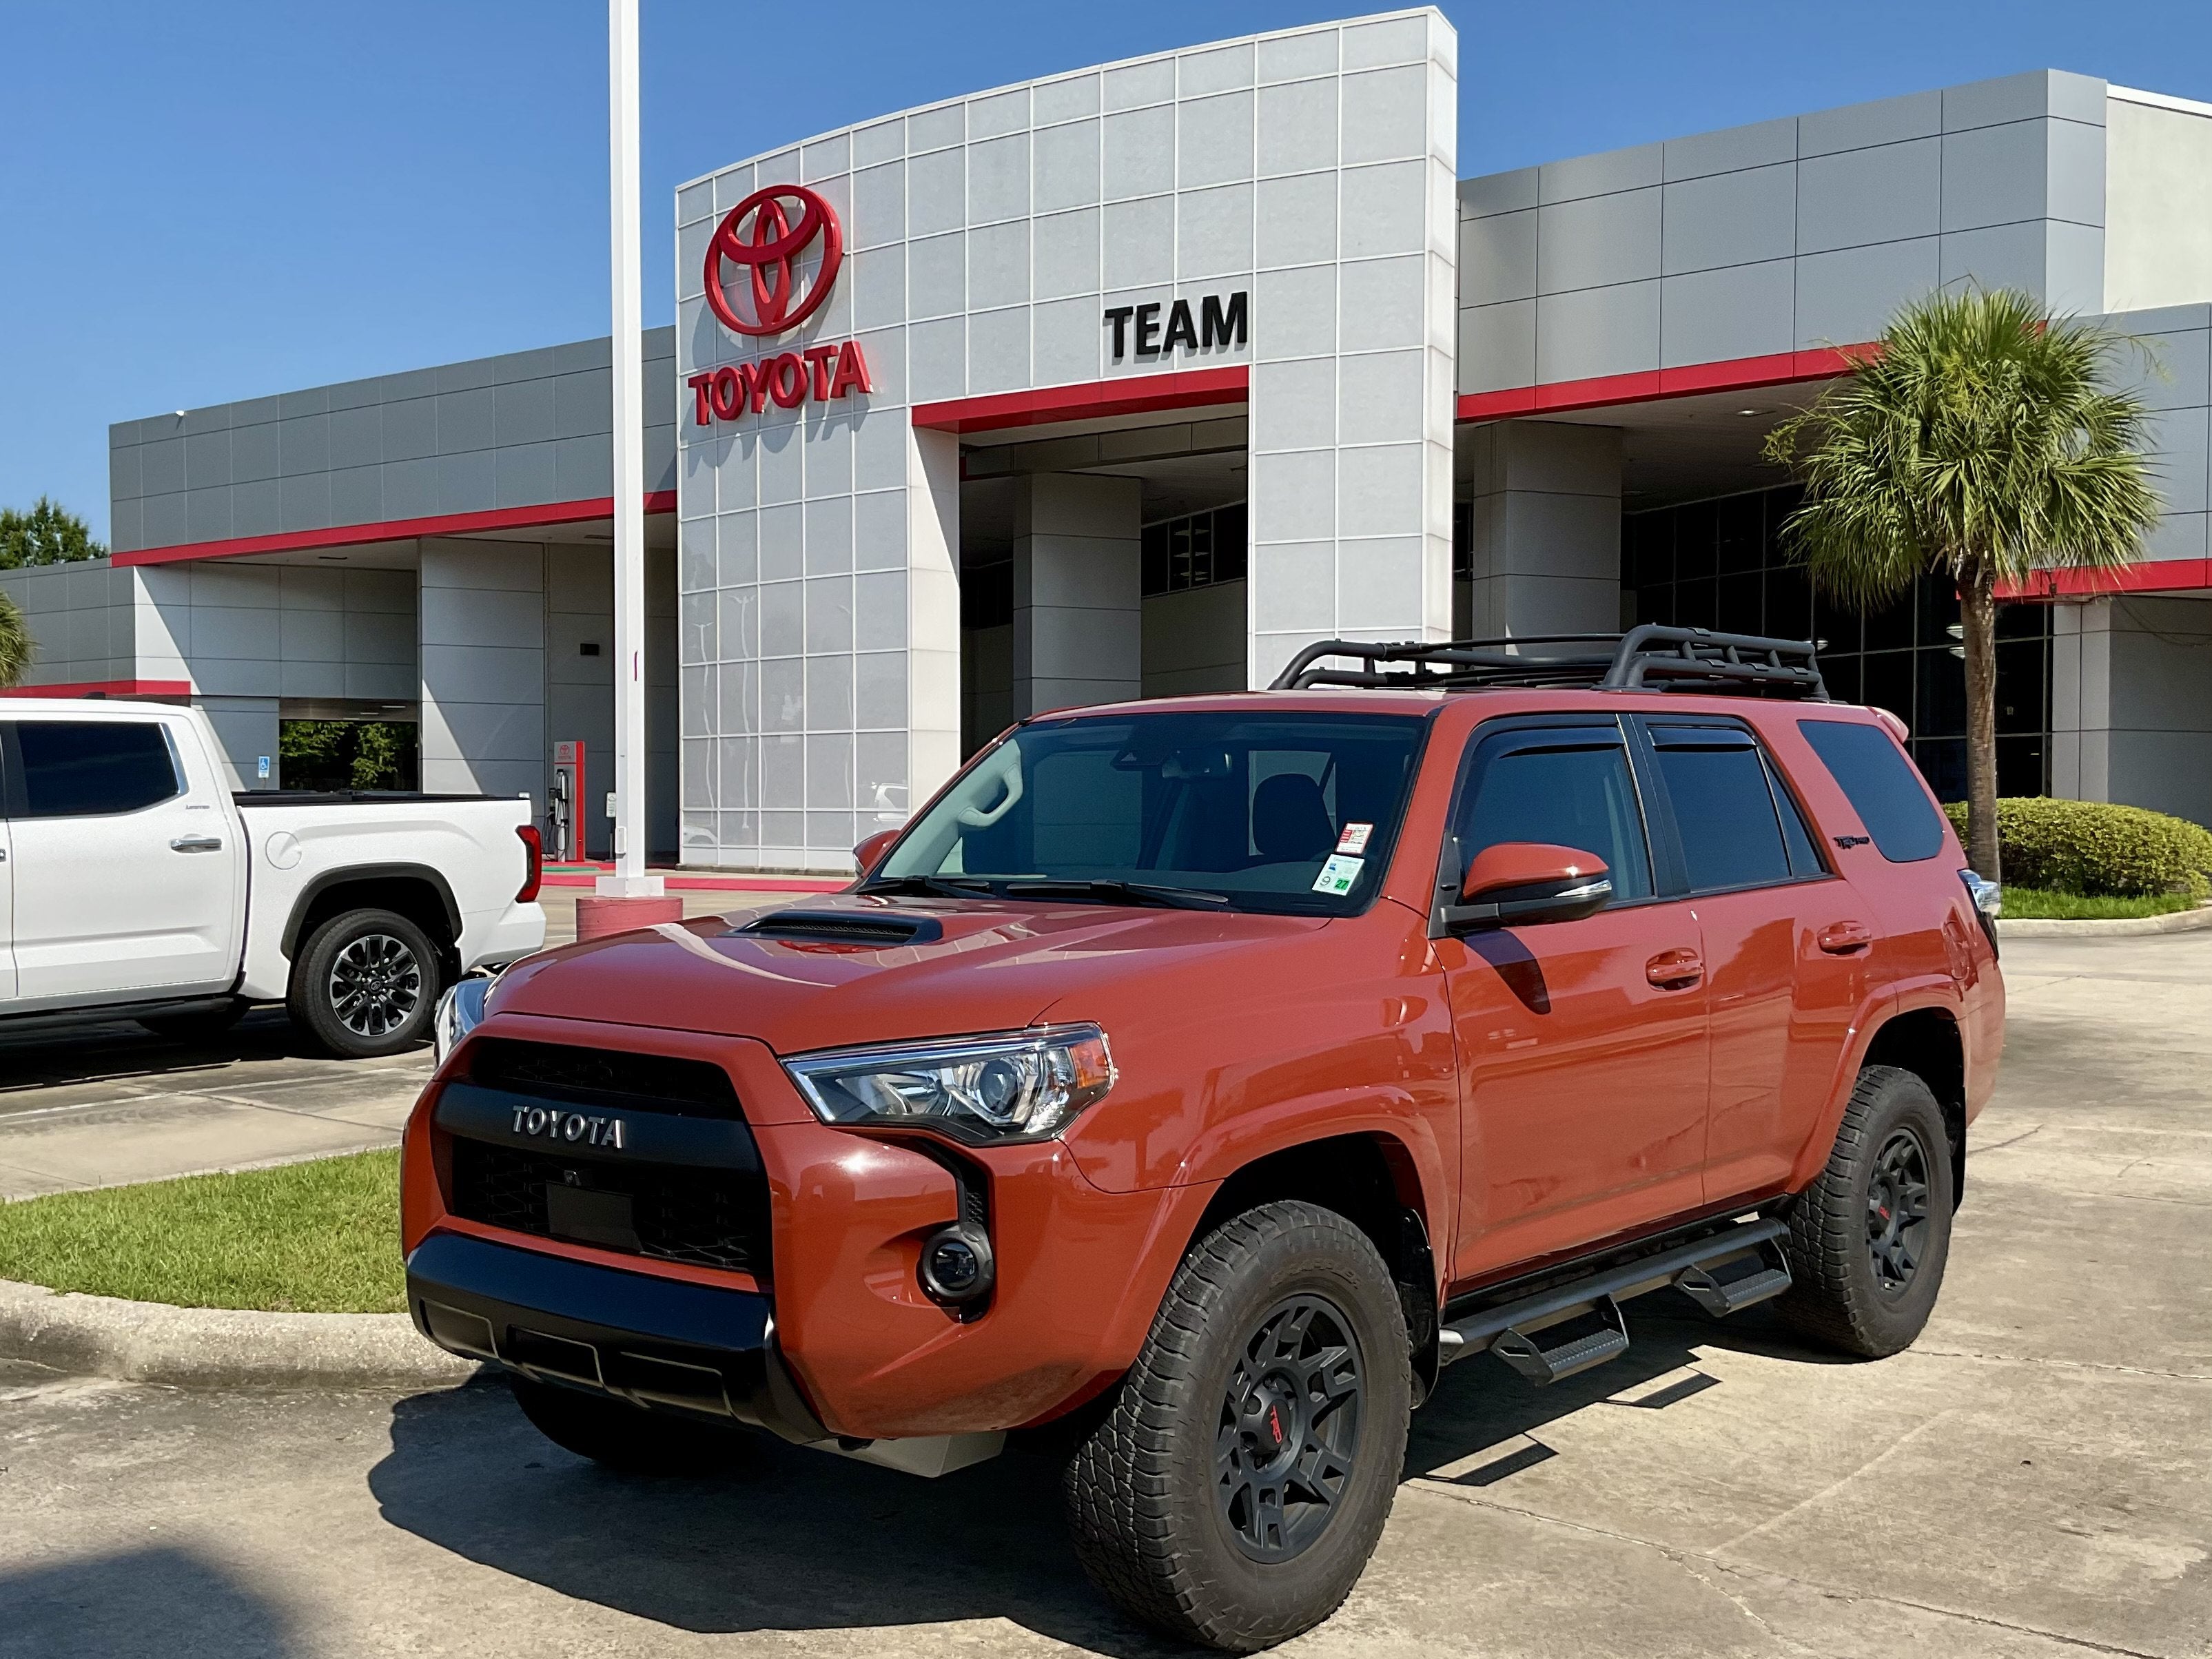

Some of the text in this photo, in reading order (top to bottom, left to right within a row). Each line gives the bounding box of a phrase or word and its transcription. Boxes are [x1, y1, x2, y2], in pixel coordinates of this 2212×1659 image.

[1105, 291, 1248, 358] TEAM
[688, 340, 872, 426] TOYOTA
[1334, 879, 1350, 889] 27
[513, 1105, 624, 1149] TOYOTA
[1270, 1405, 1282, 1444] TRD
